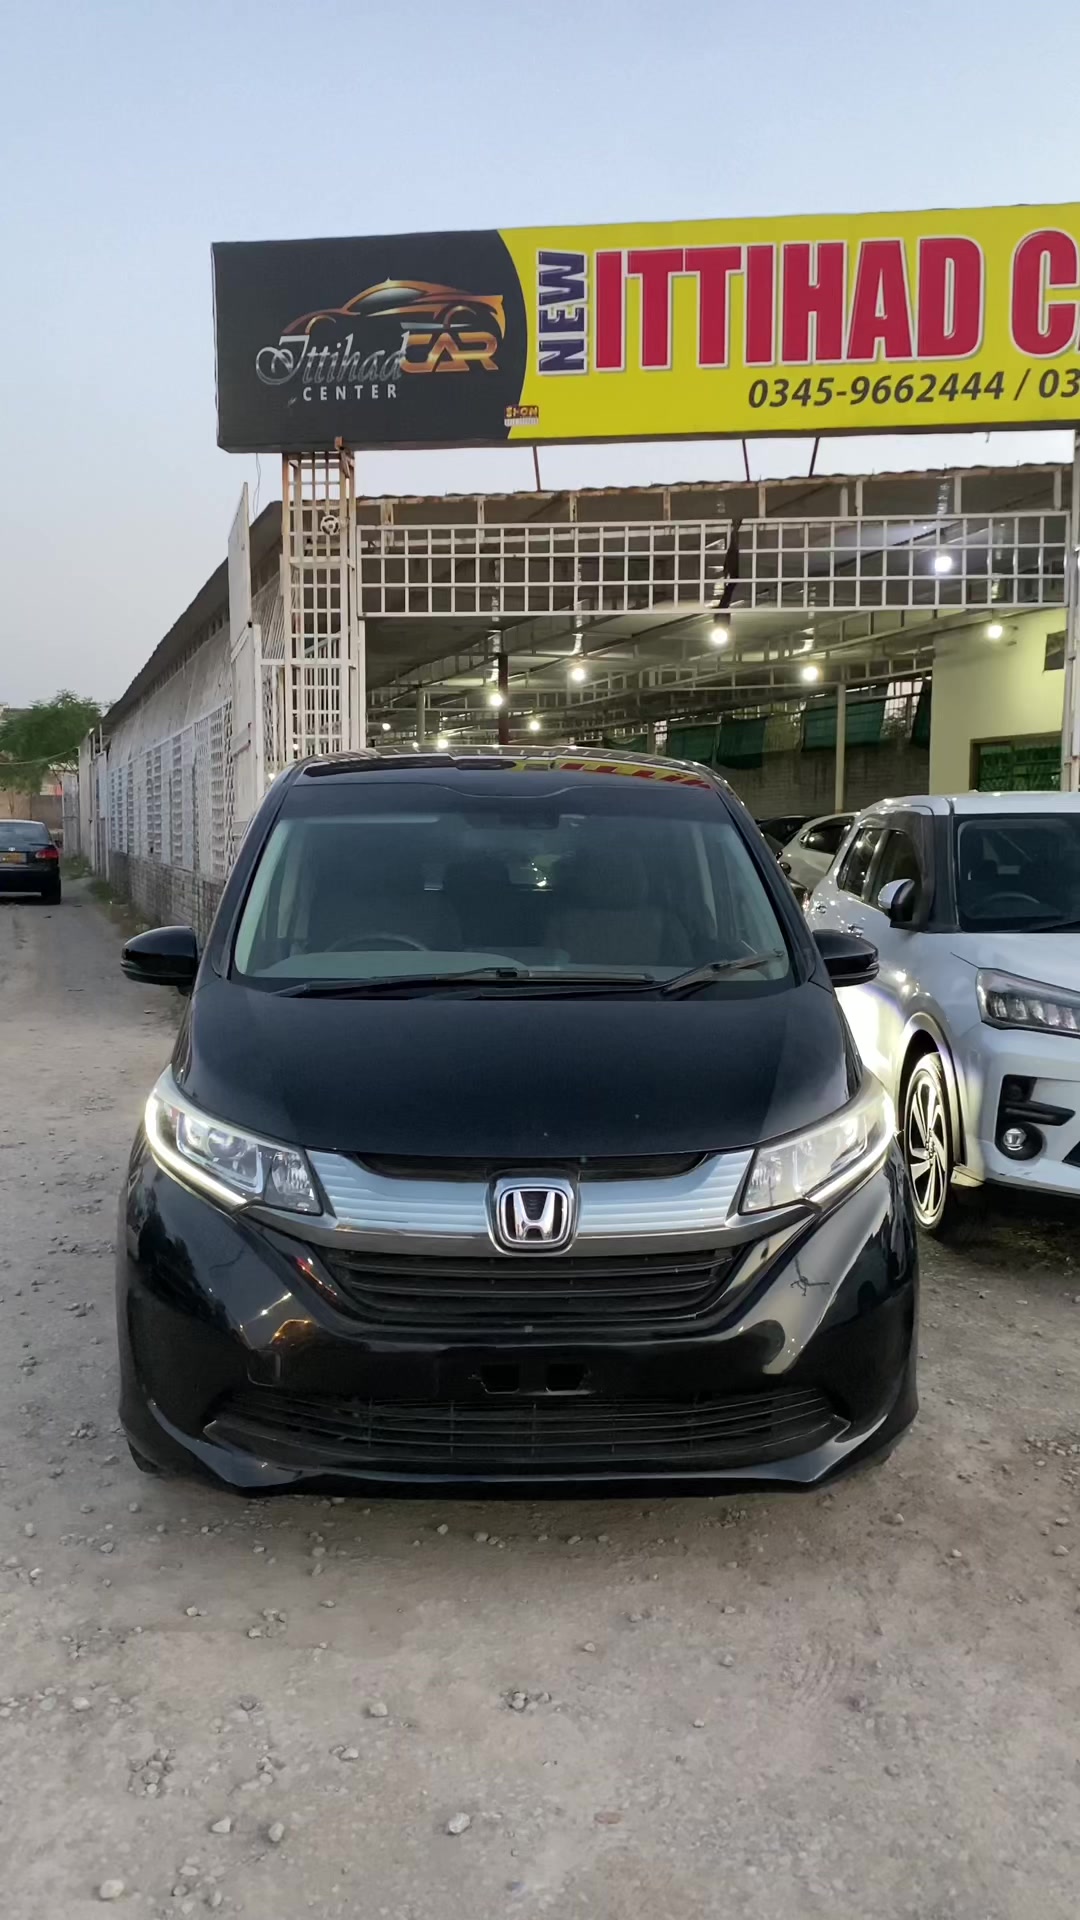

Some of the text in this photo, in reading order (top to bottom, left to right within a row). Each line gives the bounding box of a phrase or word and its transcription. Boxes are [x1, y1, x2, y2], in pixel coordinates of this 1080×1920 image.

[537, 250, 587, 373] NEW
[595, 228, 1080, 370] ITTIHAD C
[255, 331, 499, 385] Ittihad CAR
[302, 384, 397, 401] CENTER
[747, 370, 1005, 409] 0345-9662444
[1038, 367, 1080, 398] 03
